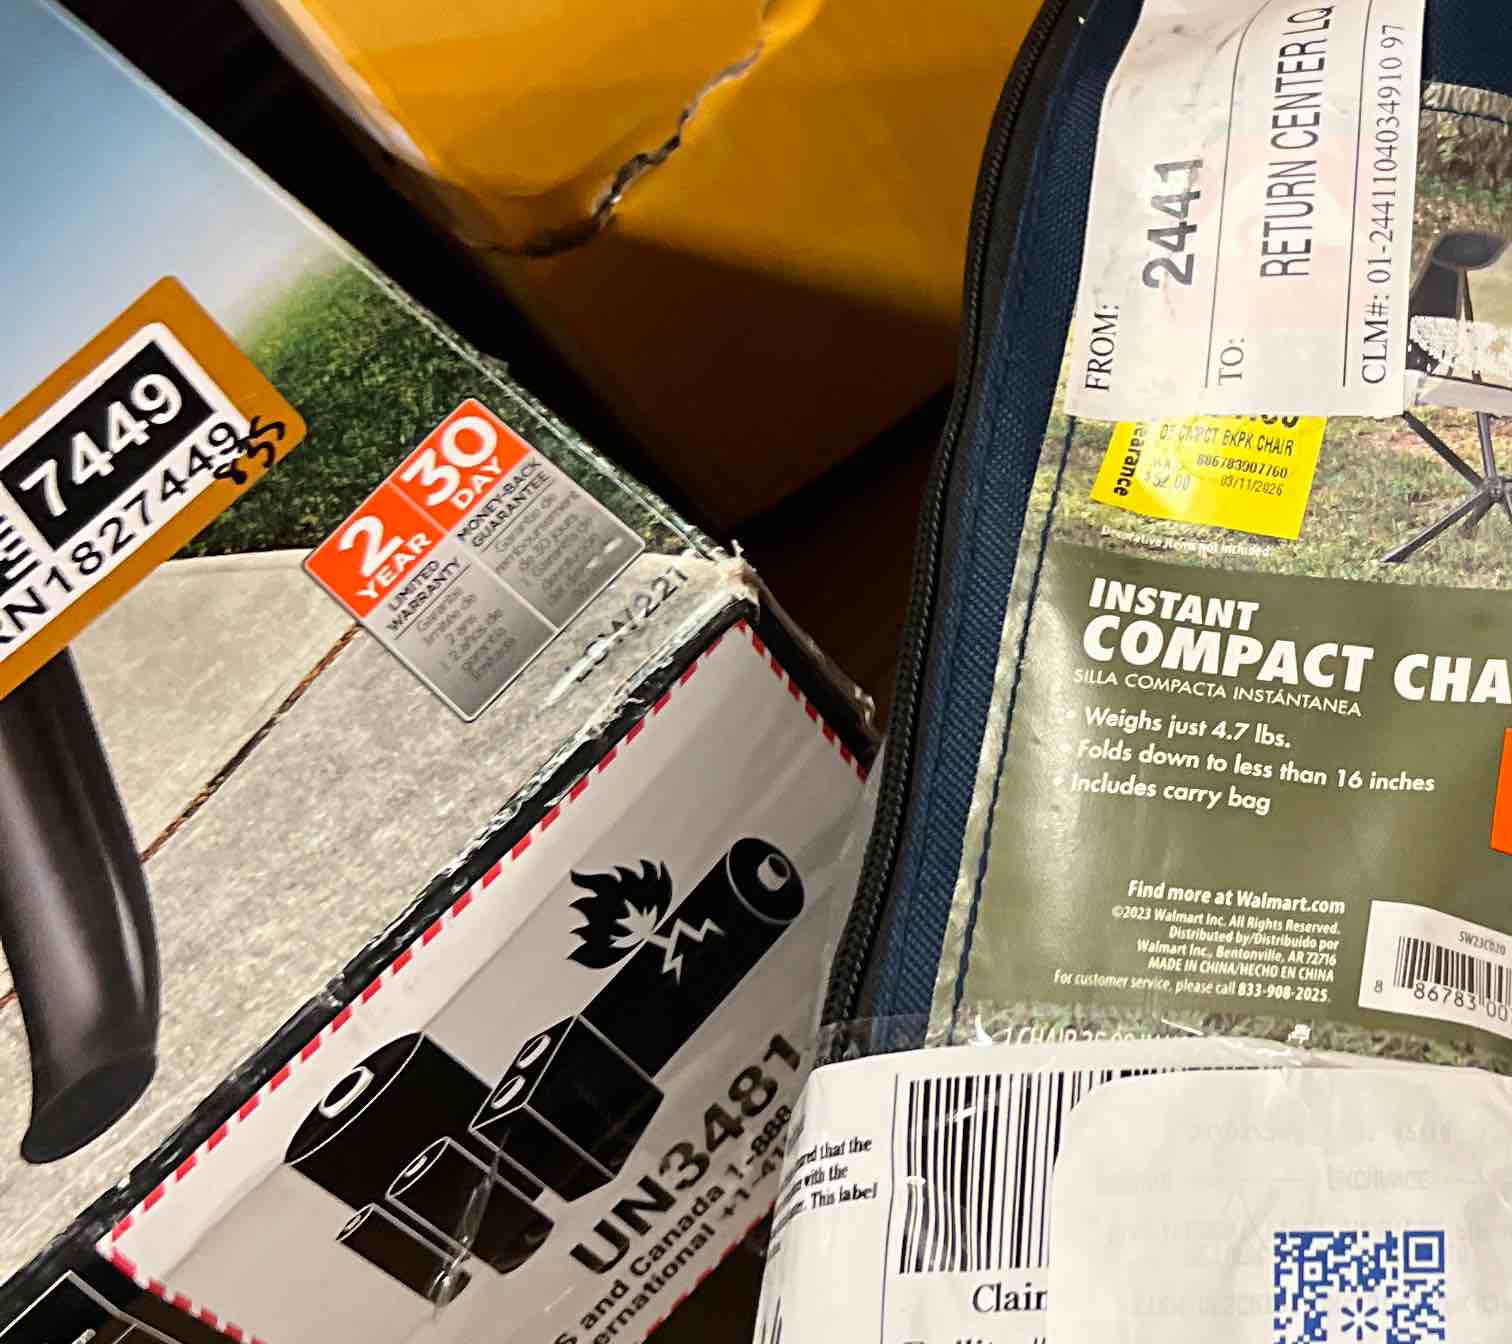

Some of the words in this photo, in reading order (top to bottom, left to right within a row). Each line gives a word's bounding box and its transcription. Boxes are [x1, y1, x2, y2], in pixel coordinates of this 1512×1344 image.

[1281, 5, 1336, 34] LQ
[1380, 23, 1405, 49] 97
[1271, 38, 1327, 147] CENTER
[1366, 55, 1404, 284] 01-2441104034910
[1140, 155, 1204, 286] 2441
[1259, 160, 1318, 276] RETURN
[1083, 301, 1119, 391] FROM:
[1216, 335, 1245, 385] TO:
[1361, 293, 1391, 384] CLM#:
[19, 373, 182, 517] 7449
[401, 415, 498, 507] 30
[1256, 436, 1293, 456] CHAIR
[453, 456, 505, 510] DAY
[455, 457, 542, 543] MONEY-BACK
[468, 471, 550, 549] GUARANTEE
[339, 514, 404, 578] 2
[356, 532, 432, 601] YEAR
[384, 556, 442, 613] LIMITED
[384, 555, 463, 633] WARRANTY
[1088, 577, 1259, 631] INSTANT
[1082, 614, 1375, 692] COMPACT
[1073, 668, 1118, 687] SILLA
[1124, 672, 1227, 700] COMPACTA
[1233, 685, 1362, 717] INSTÁNTANEA
[1084, 706, 1162, 735] Weighs
[1167, 713, 1207, 738] just
[1211, 720, 1250, 742] 4.7
[1255, 725, 1291, 749] lbs.
[1076, 738, 1132, 763] Folds
[1138, 745, 1199, 770] down
[1206, 752, 1227, 772] to
[1233, 754, 1273, 779] less
[1279, 763, 1327, 786] than
[1336, 768, 1362, 790] 16
[1369, 771, 1435, 793] inches
[1070, 773, 1157, 798] Includes
[1163, 782, 1222, 810] carry
[1228, 787, 1272, 816] bag
[1112, 905, 1152, 920] ©2023
[1154, 909, 1204, 925] Walmart
[1206, 914, 1227, 927] Inc.
[1228, 916, 1245, 928] All
[1247, 917, 1283, 932] Rights
[1285, 920, 1340, 935] Reserved.
[1127, 880, 1165, 899] Find
[1167, 887, 1210, 905] more
[1214, 890, 1232, 906] at
[1236, 890, 1345, 914] Walmart.com
[1136, 938, 1186, 955] Walmart
[1216, 946, 1285, 963] Bentonville,
[1287, 951, 1304, 963] AR
[1305, 952, 1337, 966] 72716
[1168, 926, 1233, 942] Distributed
[1236, 930, 1317, 949] by/Distribuido
[1319, 939, 1340, 951] por
[1054, 969, 1074, 984] For
[1074, 972, 1128, 989] customer
[1130, 976, 1172, 993] service,
[1175, 980, 1213, 995] please
[1216, 982, 1236, 995] call
[1238, 982, 1331, 1003] 833-908-2025.
[1148, 956, 1183, 972] MADE
[1184, 959, 1198, 972] IN
[1200, 960, 1278, 979] CHINA/HECHO
[1280, 966, 1296, 979] EN
[1298, 968, 1334, 982] CHINA
[1373, 978, 1384, 993] 8
[1412, 981, 1478, 1011] 86783
[569, 1034, 801, 1275] UN3481
[818, 1138, 845, 1158] that
[847, 1135, 872, 1154] the
[803, 1167, 824, 1186] with
[827, 1163, 848, 1181] the
[810, 1189, 835, 1209] This
[838, 1181, 877, 1203] label
[580, 1278, 630, 1331] and
[629, 1185, 726, 1278] Canada
